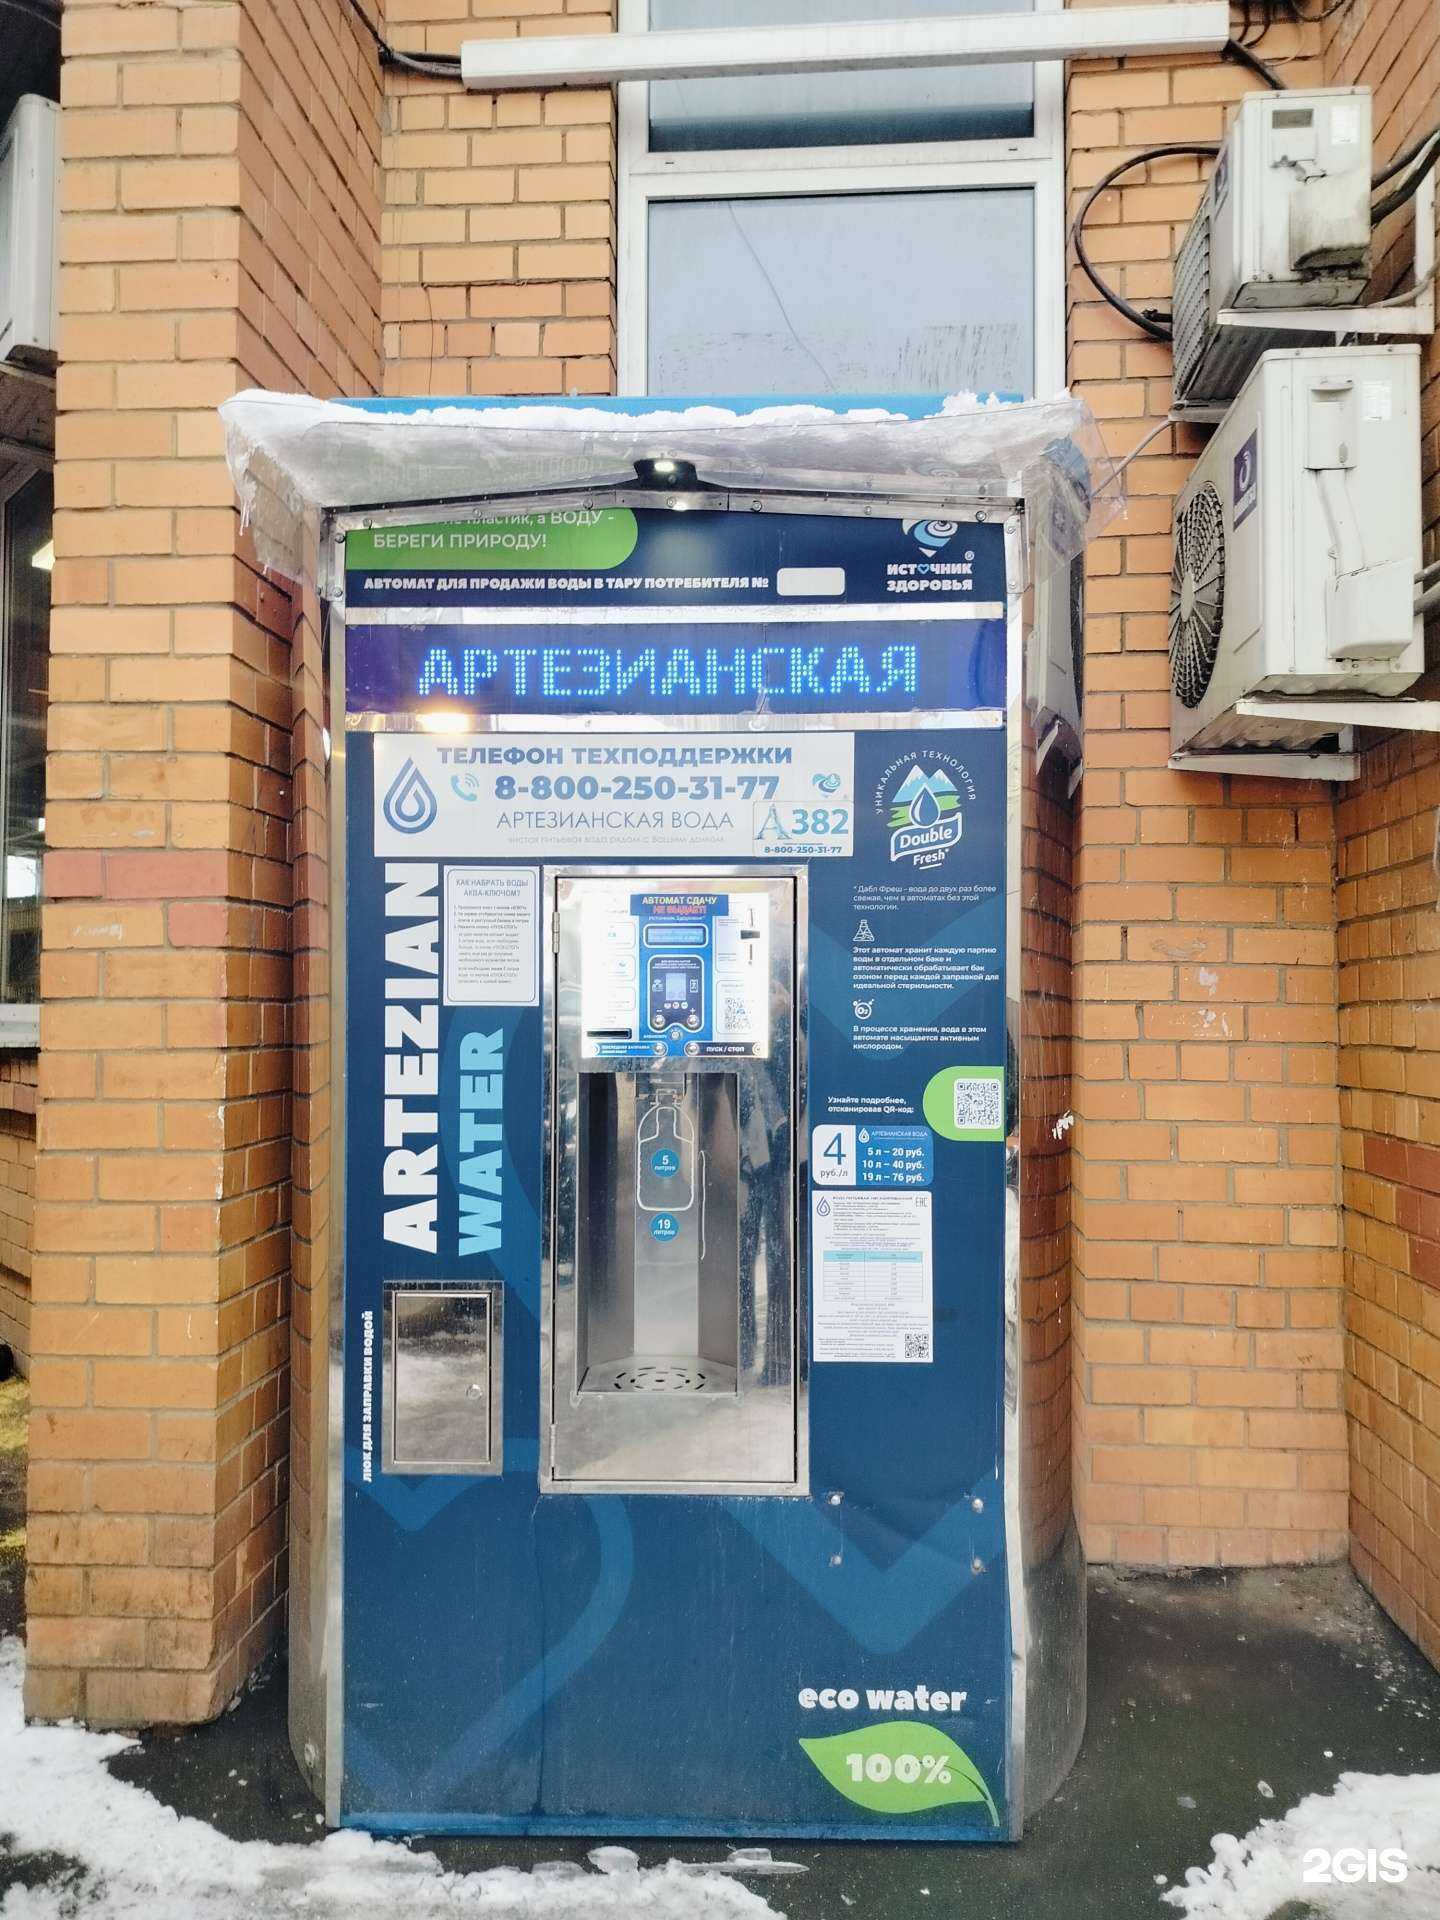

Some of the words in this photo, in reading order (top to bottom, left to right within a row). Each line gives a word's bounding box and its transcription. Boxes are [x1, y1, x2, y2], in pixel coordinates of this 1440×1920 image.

[537, 514, 546, 525] а
[551, 510, 604, 527] ВОДУ
[373, 534, 444, 549] БЕРЕГИ
[450, 533, 547, 550] ПРИРОДУ!
[363, 577, 433, 590] АВТОМАТ
[436, 577, 468, 590] ДЛЯ
[469, 577, 546, 591] ПРОДАЖИ
[547, 577, 592, 590] ВОДЫ
[594, 577, 602, 590] В
[605, 577, 642, 590] ТАРУ
[644, 576, 750, 590] ПОТРЕБИТЕЛЯ
[751, 576, 769, 588] №
[886, 578, 973, 592] ЗДОРОВЬЯ
[416, 645, 916, 696] АРТЕЗИАНСКАЯ
[437, 746, 564, 765] ТЕЛЕФОН
[571, 746, 792, 768] ТЕХПОДДЕРЖКИ
[494, 775, 780, 801] 8-800-250-31-77
[873, 751, 917, 815] УНИКАЛЬНАЯ
[921, 750, 977, 801] ТЕХНОЛОГИЯ
[496, 810, 664, 829] АРТЕЗИАНСКАЯ
[671, 810, 735, 831] ВОДА
[791, 808, 849, 835] 382
[899, 826, 953, 849] Double
[763, 845, 843, 855] 8-800-250-31-77
[456, 879, 470, 887] КАК
[471, 879, 505, 887] НАБРАТЬ
[506, 879, 529, 888] ВОДЫ
[463, 889, 521, 897] АКВА-КЛЮЧОМ?
[857, 885, 878, 893] Дабл
[958, 886, 972, 894] раз
[973, 885, 997, 893] более
[642, 896, 685, 905] АВТОМАТ
[686, 896, 717, 906] СДАЧУ
[946, 894, 961, 902] без
[961, 894, 980, 902] этой
[853, 903, 899, 911] технологии.
[853, 946, 871, 954] Этот
[904, 947, 933, 955] хранит
[933, 947, 966, 956] каждую
[966, 947, 997, 955] партию
[925, 955, 945, 963] баке
[853, 964, 913, 972] автоматически
[913, 964, 969, 972] обрабатывает
[970, 964, 985, 972] бак
[909, 973, 940, 981] каждой
[941, 973, 984, 982] заправкой
[853, 982, 897, 990] идеальной
[896, 982, 955, 990] стерильности.
[899, 1026, 940, 1034] хранения,
[941, 1026, 960, 1034] вода
[853, 1034, 889, 1042] автомате
[890, 1034, 939, 1043] насыщается
[939, 1034, 980, 1042] активным
[853, 1043, 904, 1051] кислородом.
[383, 862, 439, 1254] ARTEZIAN
[827, 1096, 860, 1105] Узнайте
[860, 1096, 907, 1106] подробнее,
[827, 1106, 882, 1114] отсканировав
[871, 1130, 912, 1138] АРТЕЗИАНСКАЯ
[912, 1130, 928, 1138] ВОДА
[458, 1028, 504, 1256] WATER
[822, 1131, 847, 1166] 4
[867, 1147, 873, 1157] 5
[874, 1149, 882, 1157] л
[892, 1147, 904, 1157] 20
[905, 1147, 925, 1158] руб.
[662, 1155, 669, 1165] 5
[862, 1160, 873, 1169] 10
[874, 1161, 882, 1169] л
[892, 1160, 904, 1169] 40
[905, 1160, 925, 1171] руб.
[819, 1167, 849, 1178] руб./л
[862, 1172, 873, 1182] 19
[874, 1174, 882, 1182] л
[892, 1172, 904, 1182] 76
[905, 1172, 925, 1183] руб.
[657, 1219, 671, 1229] 19
[361, 1310, 374, 1356] ВОДОЙ
[362, 1356, 373, 1424] ЗАПРАВКИ
[362, 1424, 373, 1451] ДЛЯ
[362, 1452, 373, 1483] ЛЮК
[798, 1687, 860, 1710] eco
[865, 1685, 968, 1712] water
[846, 1753, 952, 1785] 100%
